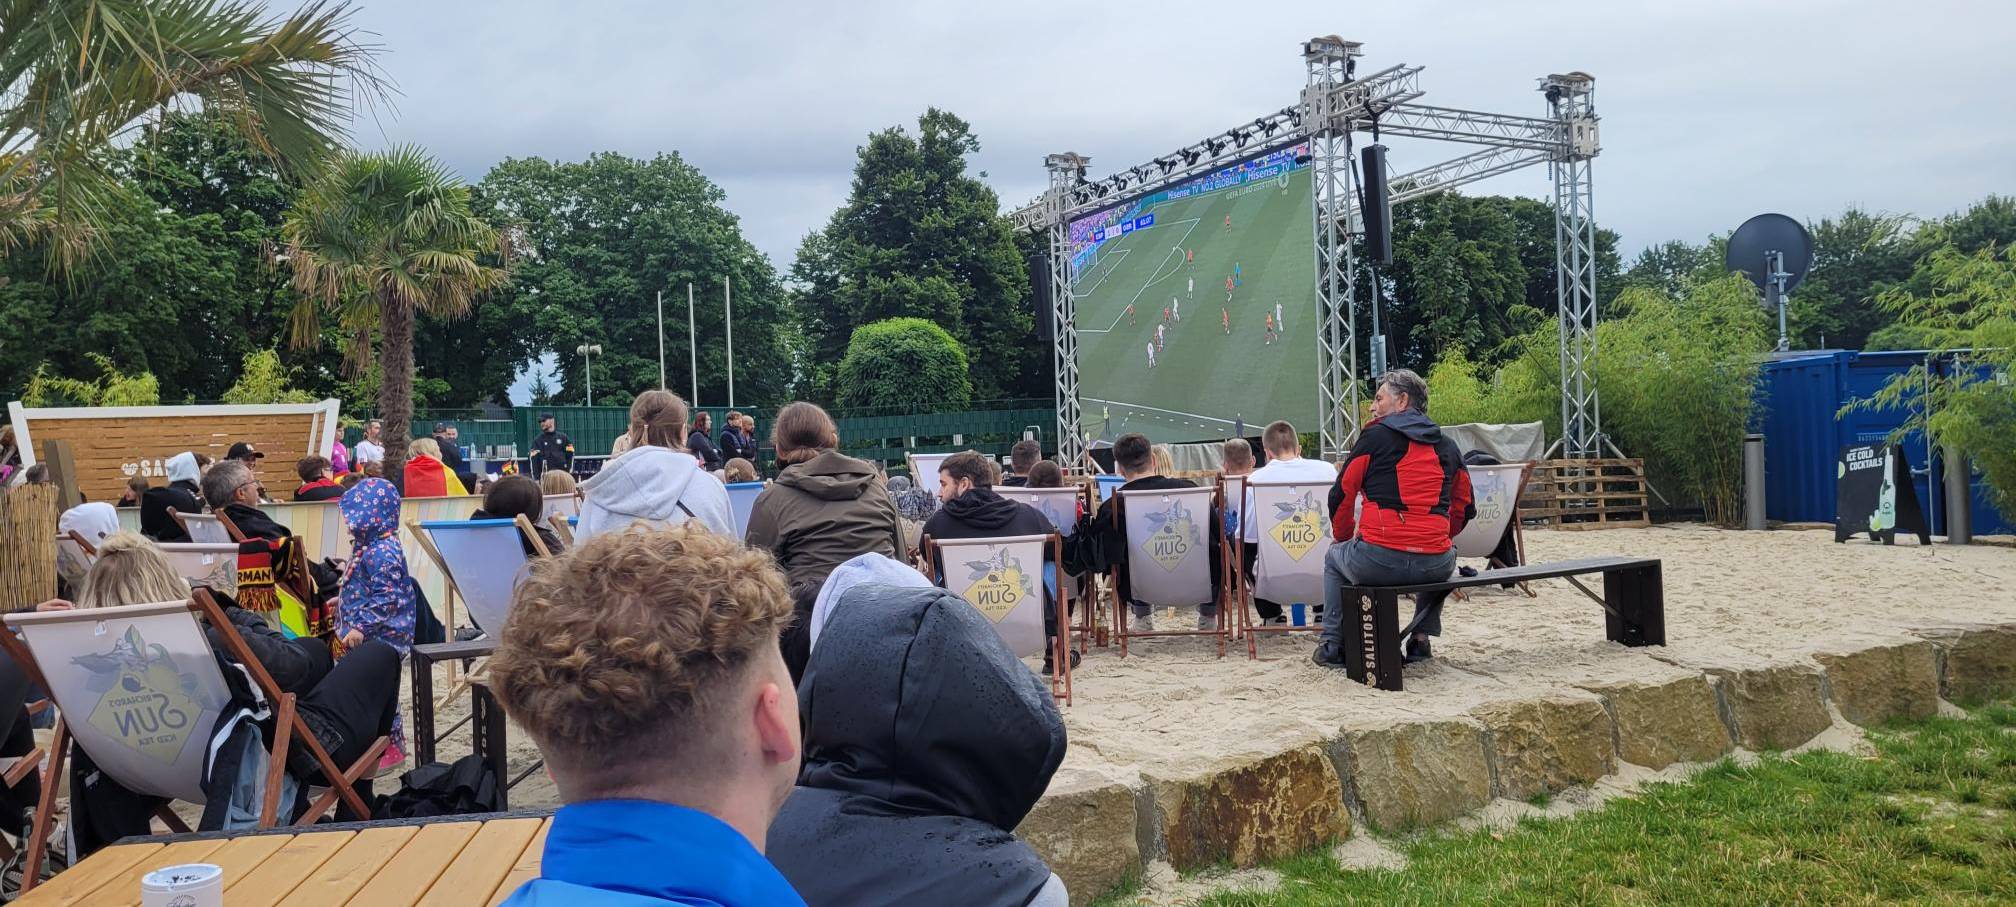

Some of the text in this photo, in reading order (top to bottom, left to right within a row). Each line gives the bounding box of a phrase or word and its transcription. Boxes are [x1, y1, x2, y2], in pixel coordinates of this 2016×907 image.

[1247, 165, 1278, 181] Hisense
[1281, 160, 1291, 173] TV
[1846, 452, 1856, 462] ICE
[1857, 449, 1873, 460] COLD
[1849, 457, 1883, 471] COCKTAILS
[1362, 614, 1375, 669] SALITOS
